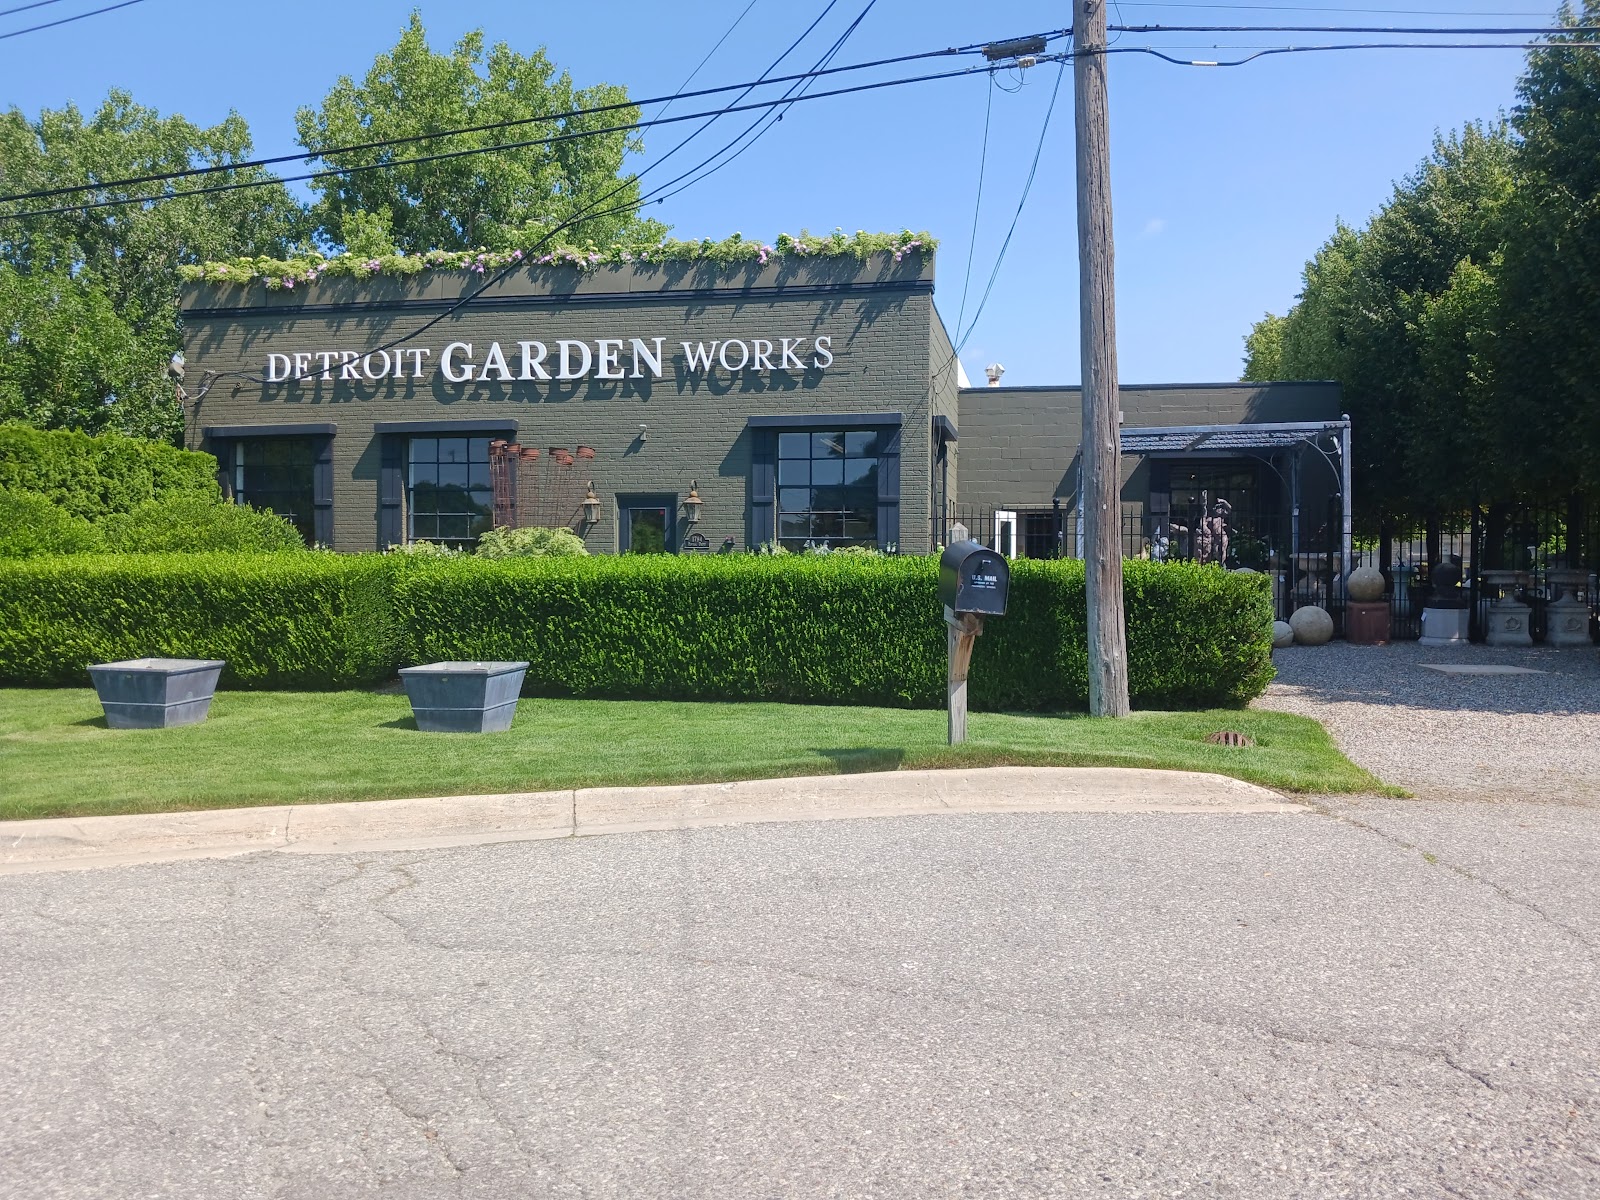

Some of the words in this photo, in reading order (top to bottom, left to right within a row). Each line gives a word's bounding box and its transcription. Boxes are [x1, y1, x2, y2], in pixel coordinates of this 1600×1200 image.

[267, 348, 430, 383] DETROIT
[441, 337, 667, 383] GARDEN
[680, 336, 834, 372] WORKS
